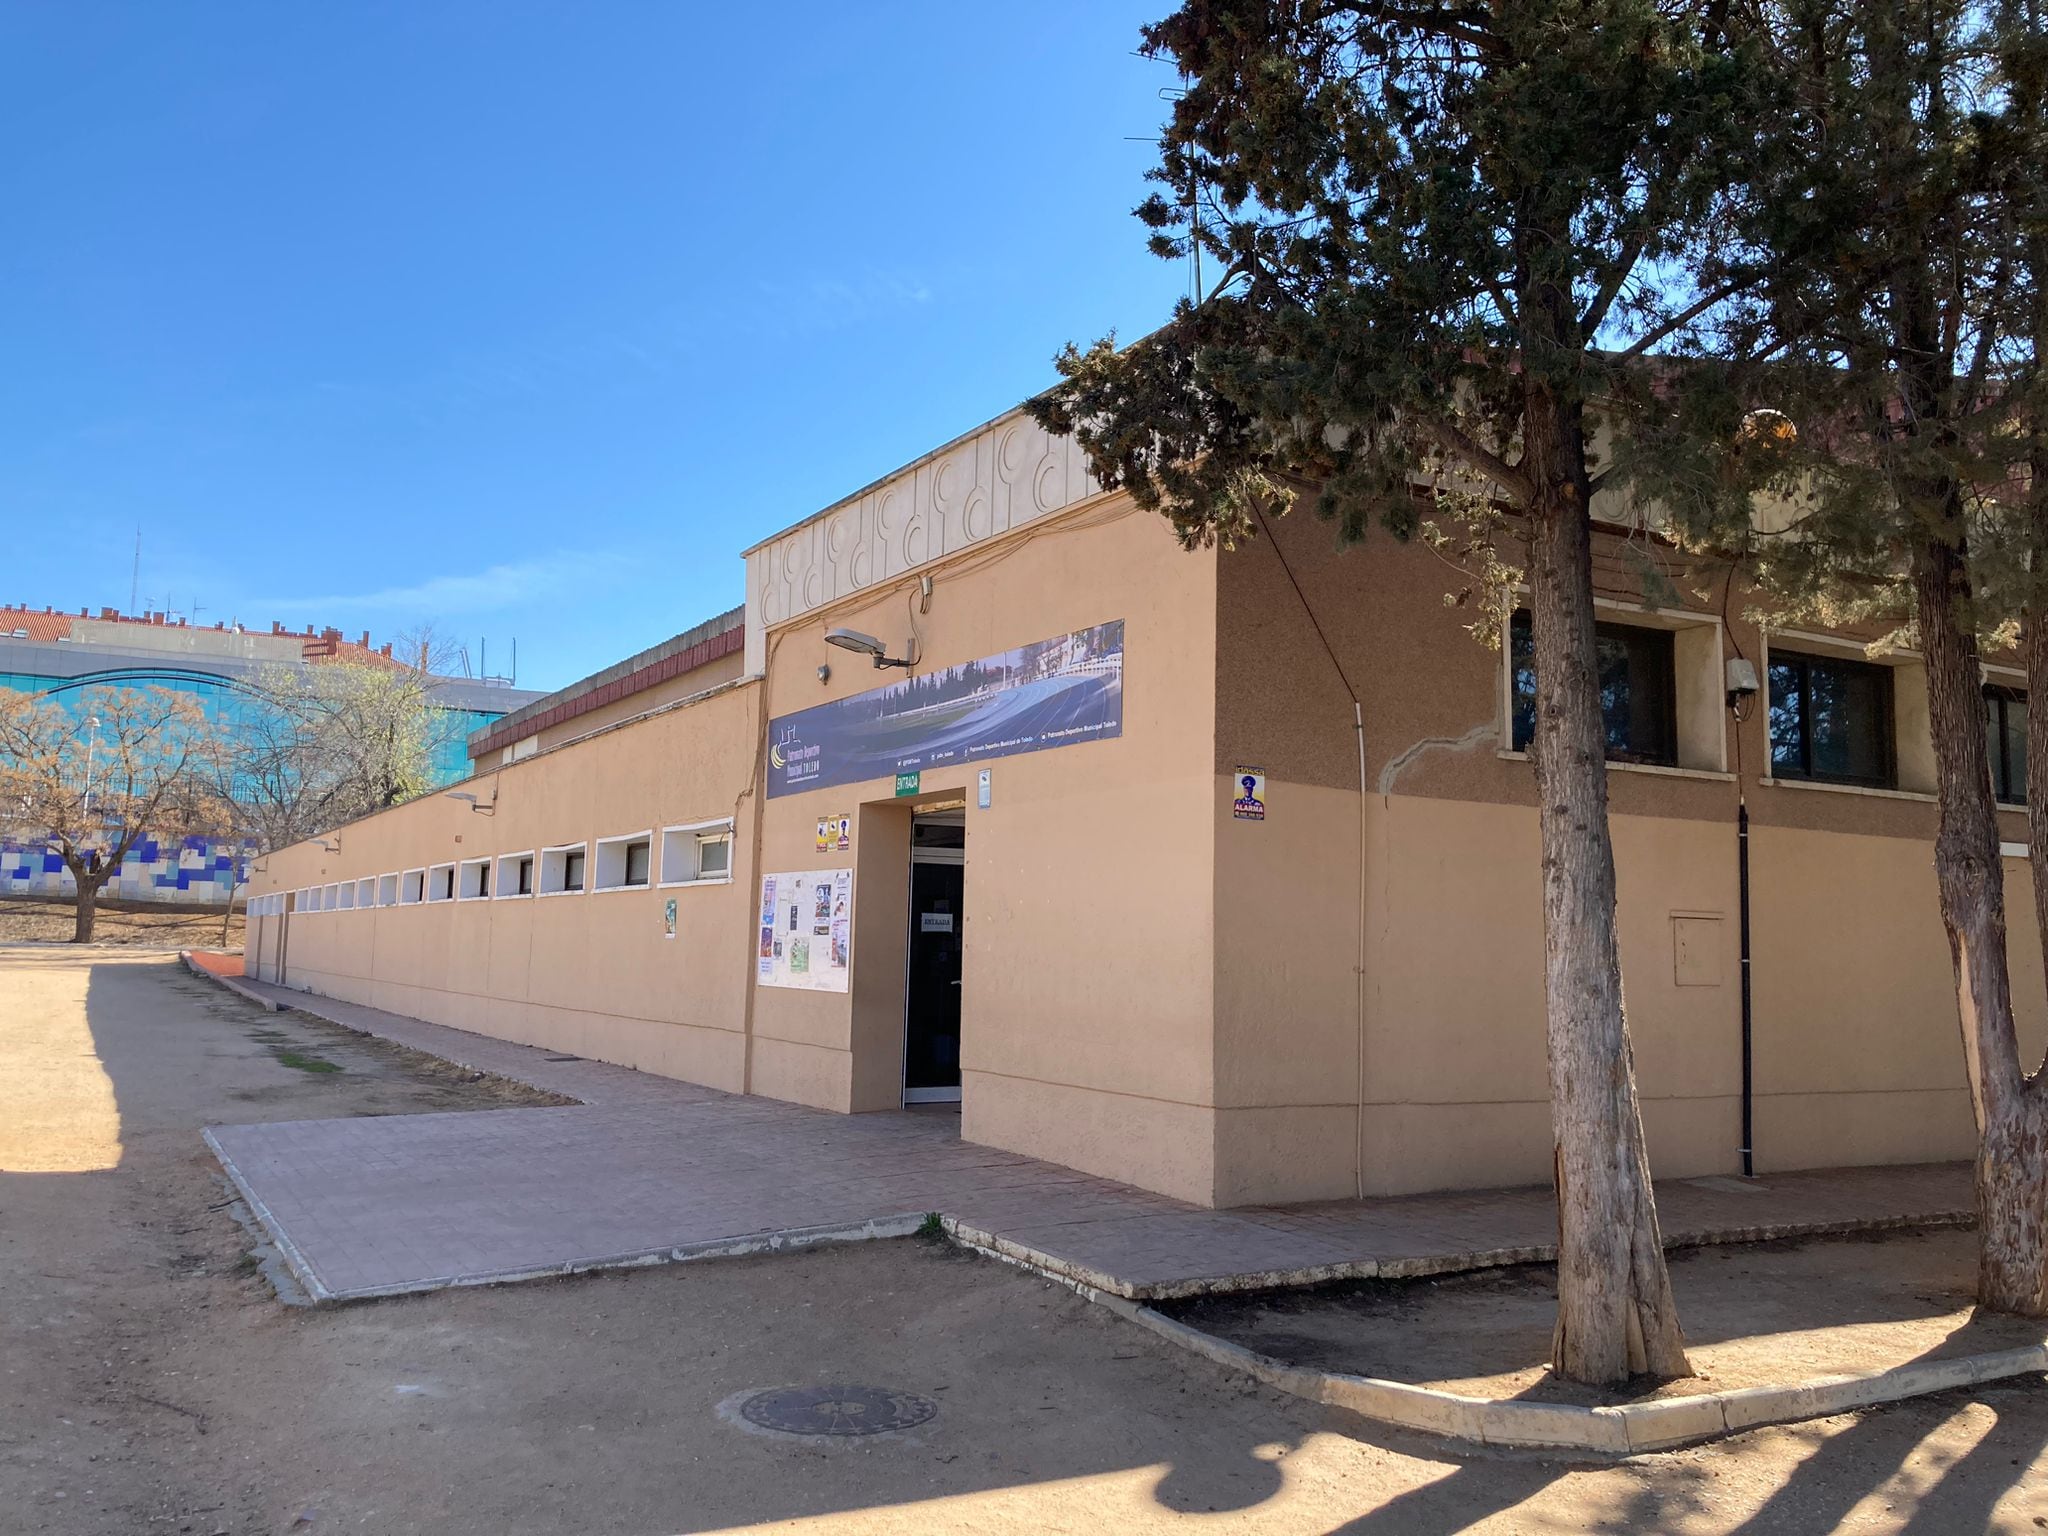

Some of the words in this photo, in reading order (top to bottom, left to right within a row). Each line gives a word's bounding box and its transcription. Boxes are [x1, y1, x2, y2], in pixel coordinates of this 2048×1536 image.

[803, 759, 820, 774] TOLEDO
[897, 775, 918, 790] ENTRADA
[1234, 804, 1263, 812] ALARMA
